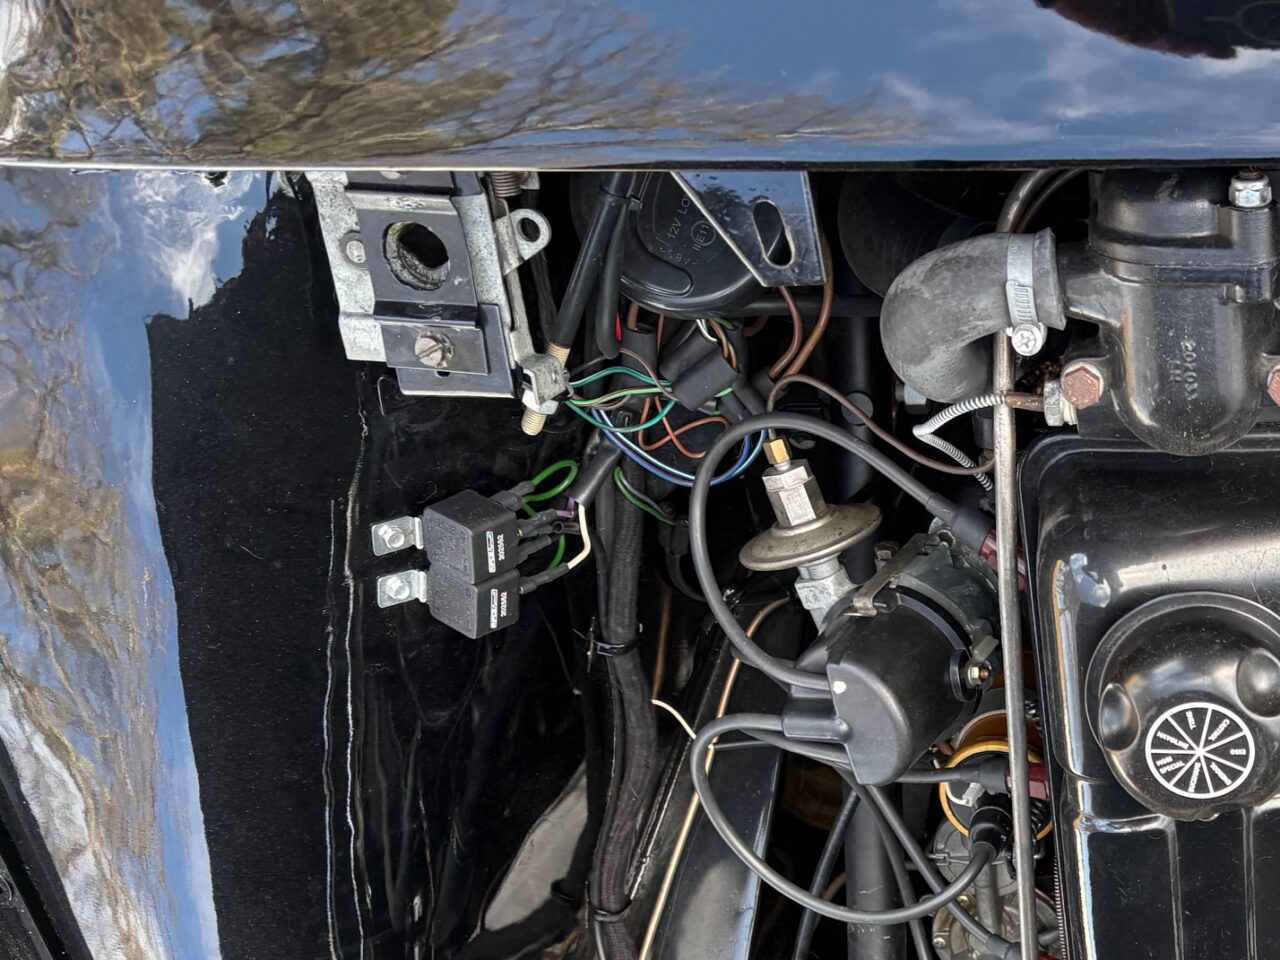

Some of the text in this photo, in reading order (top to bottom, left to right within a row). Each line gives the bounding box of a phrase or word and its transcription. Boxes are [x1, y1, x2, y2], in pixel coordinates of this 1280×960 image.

[668, 194, 692, 239] 12V LO
[1186, 710, 1196, 730] SHELL
[1156, 731, 1190, 750] HAVOLINE
[1230, 748, 1246, 756] ESSO
[1159, 760, 1186, 774] SPECIAL
